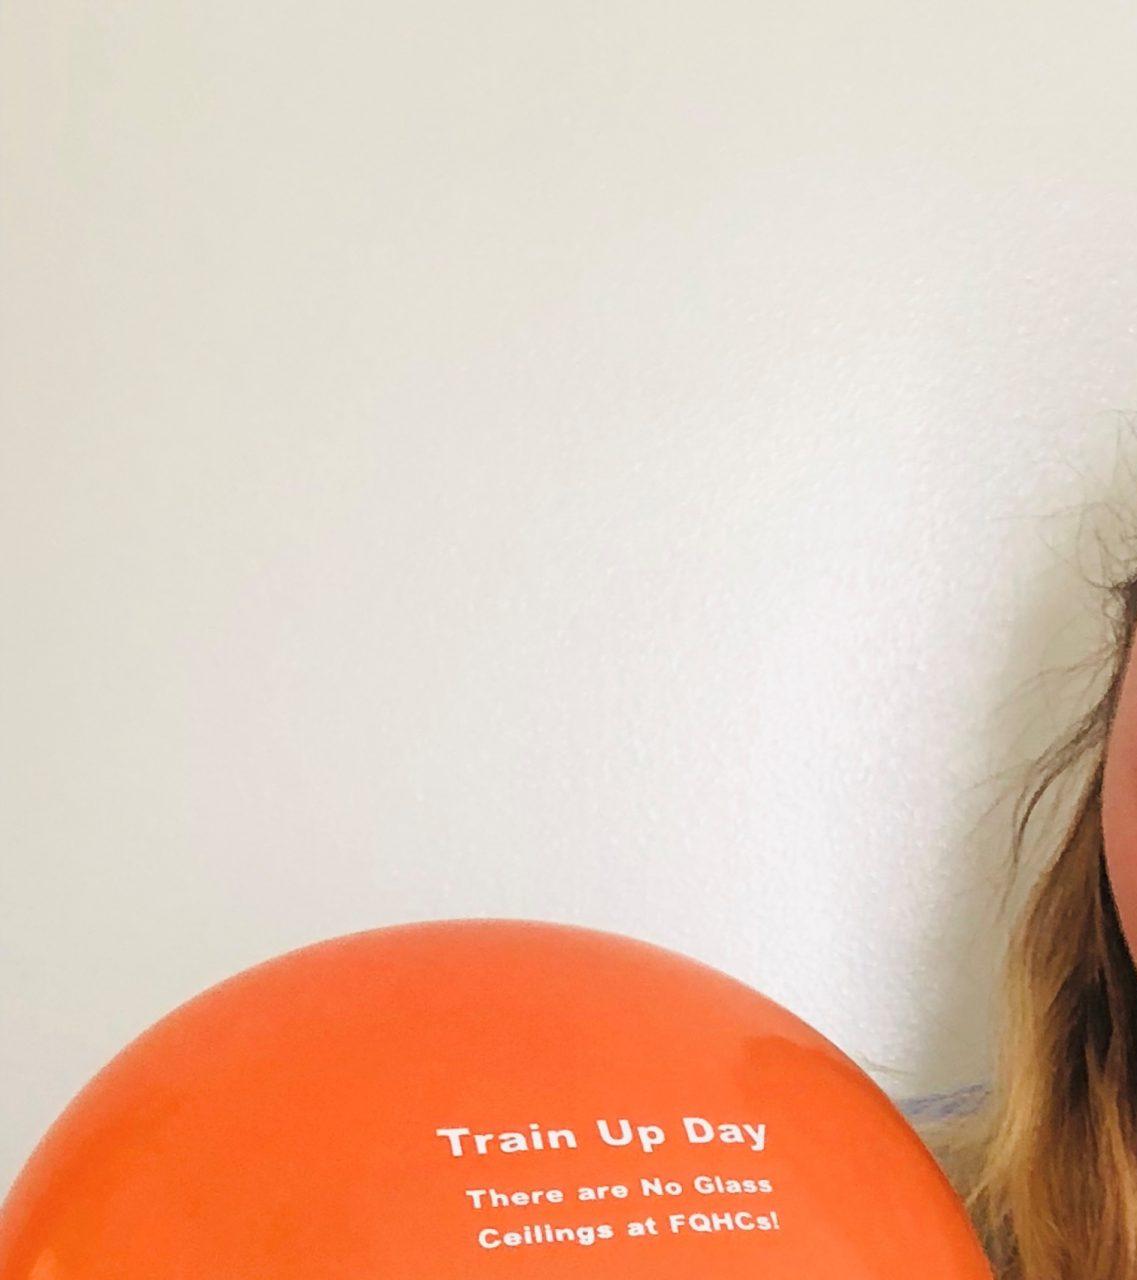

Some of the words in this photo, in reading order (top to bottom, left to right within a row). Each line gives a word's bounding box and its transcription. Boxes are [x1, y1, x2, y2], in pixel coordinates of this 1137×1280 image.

[435, 1123, 577, 1157] Train
[596, 1119, 665, 1152] Up
[683, 1116, 766, 1151] Day
[466, 1187, 564, 1209] There
[578, 1184, 629, 1201] are
[640, 1177, 683, 1197] No
[694, 1175, 773, 1195] Glass
[477, 1223, 614, 1249] Ceilings
[627, 1216, 659, 1236] at
[669, 1211, 780, 1234] FQHCs!
